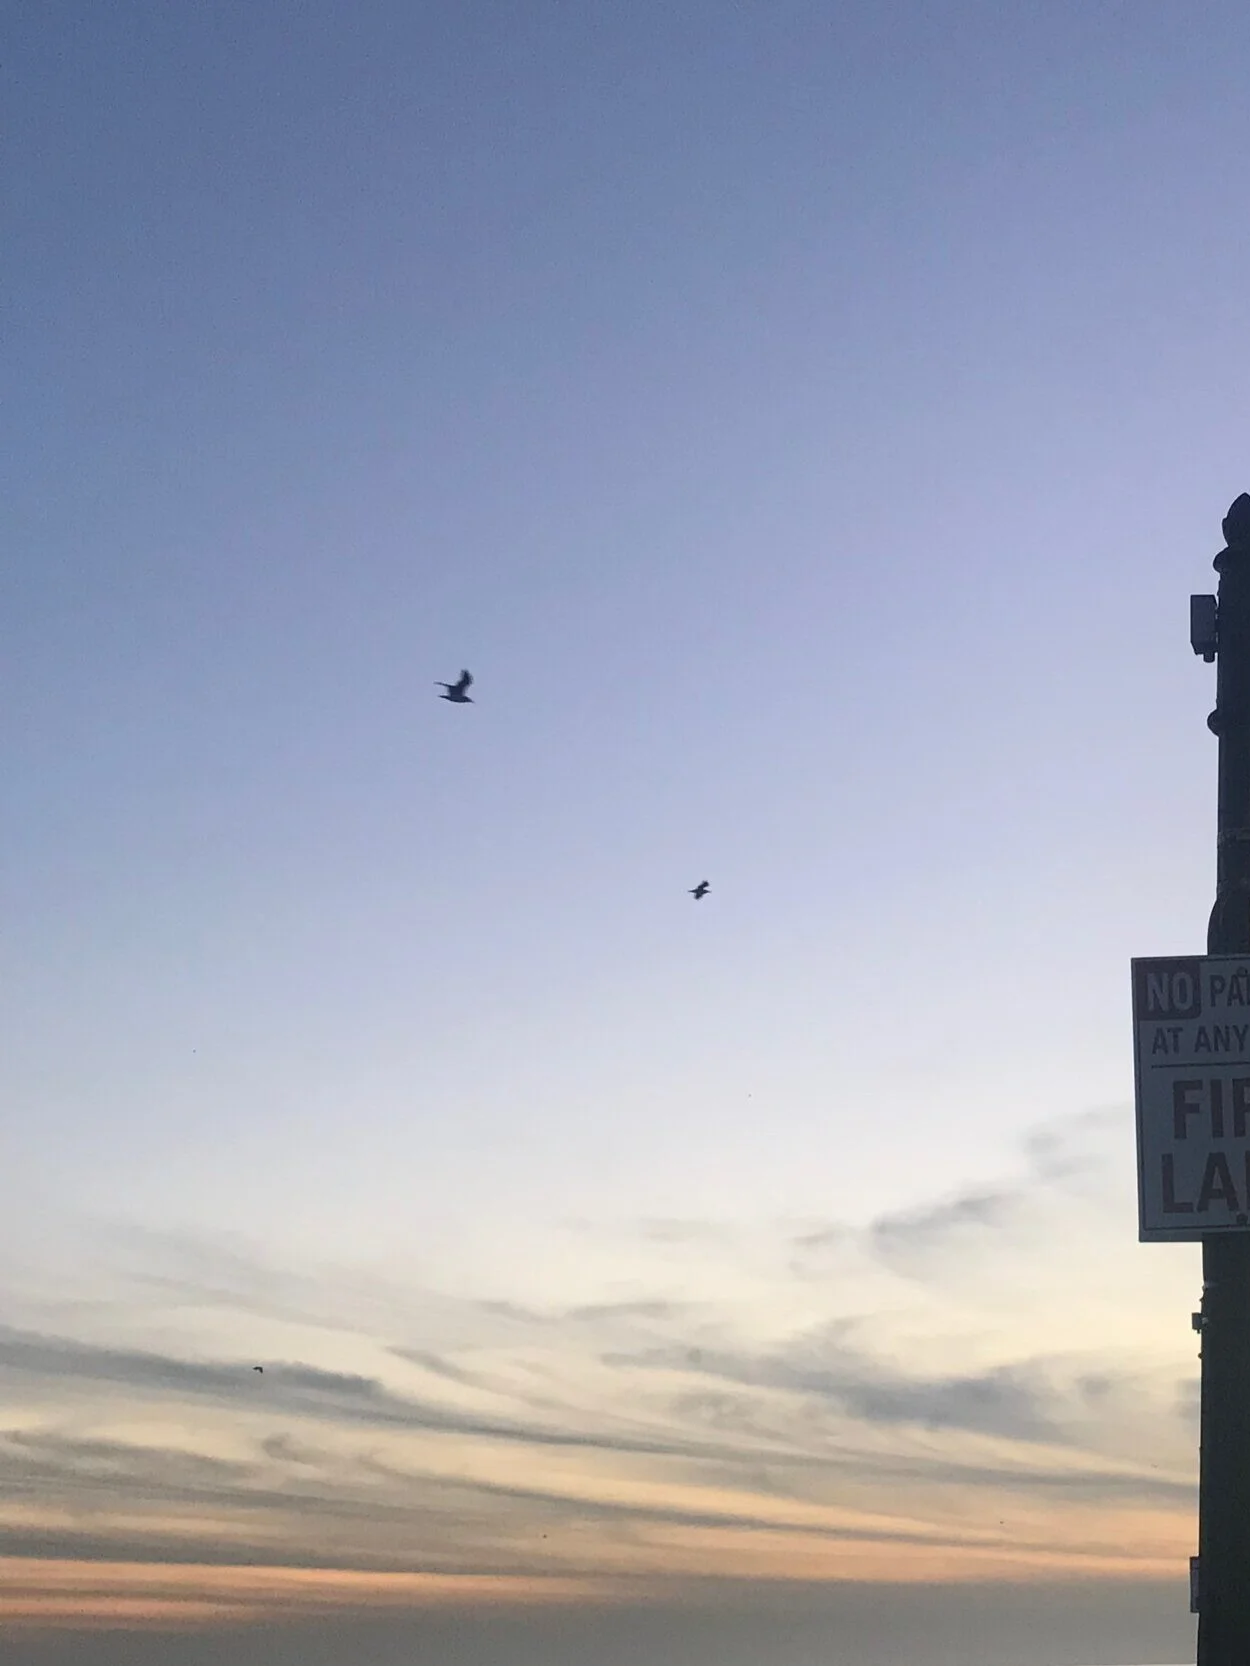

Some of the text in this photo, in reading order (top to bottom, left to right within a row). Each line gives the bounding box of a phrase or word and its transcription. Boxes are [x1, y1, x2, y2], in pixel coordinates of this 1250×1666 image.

[1147, 972, 1194, 1013] NO
[1151, 1026, 1183, 1054] AT
[1194, 1024, 1248, 1053] ANY
